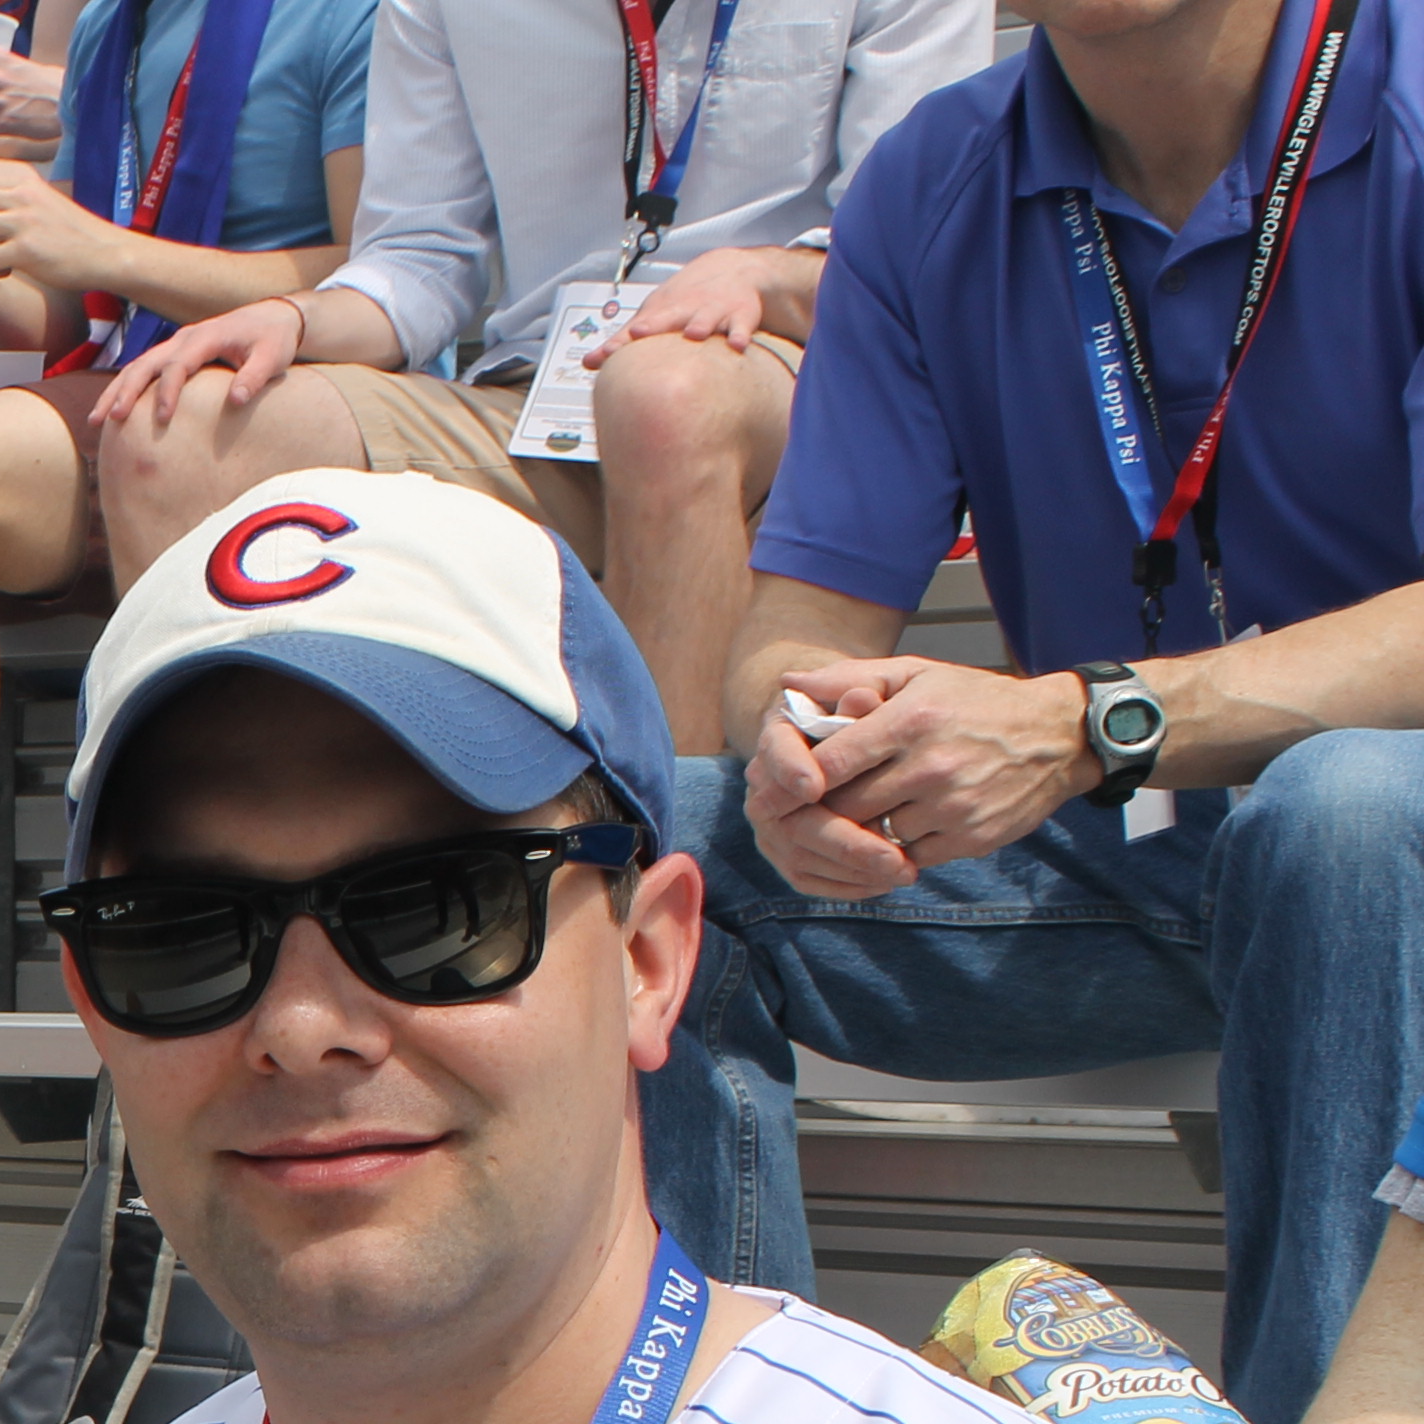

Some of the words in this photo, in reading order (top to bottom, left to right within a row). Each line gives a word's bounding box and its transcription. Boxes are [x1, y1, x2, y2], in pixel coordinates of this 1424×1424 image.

[1061, 188, 1084, 238] appa
[1091, 322, 1118, 357] Phi
[1100, 361, 1127, 430] Kappa
[1116, 434, 1141, 465] Psi
[205, 502, 359, 611] C
[659, 1267, 699, 1317] Phi
[617, 1314, 688, 1421] Kappa
[1062, 1368, 1185, 1409] Potato
